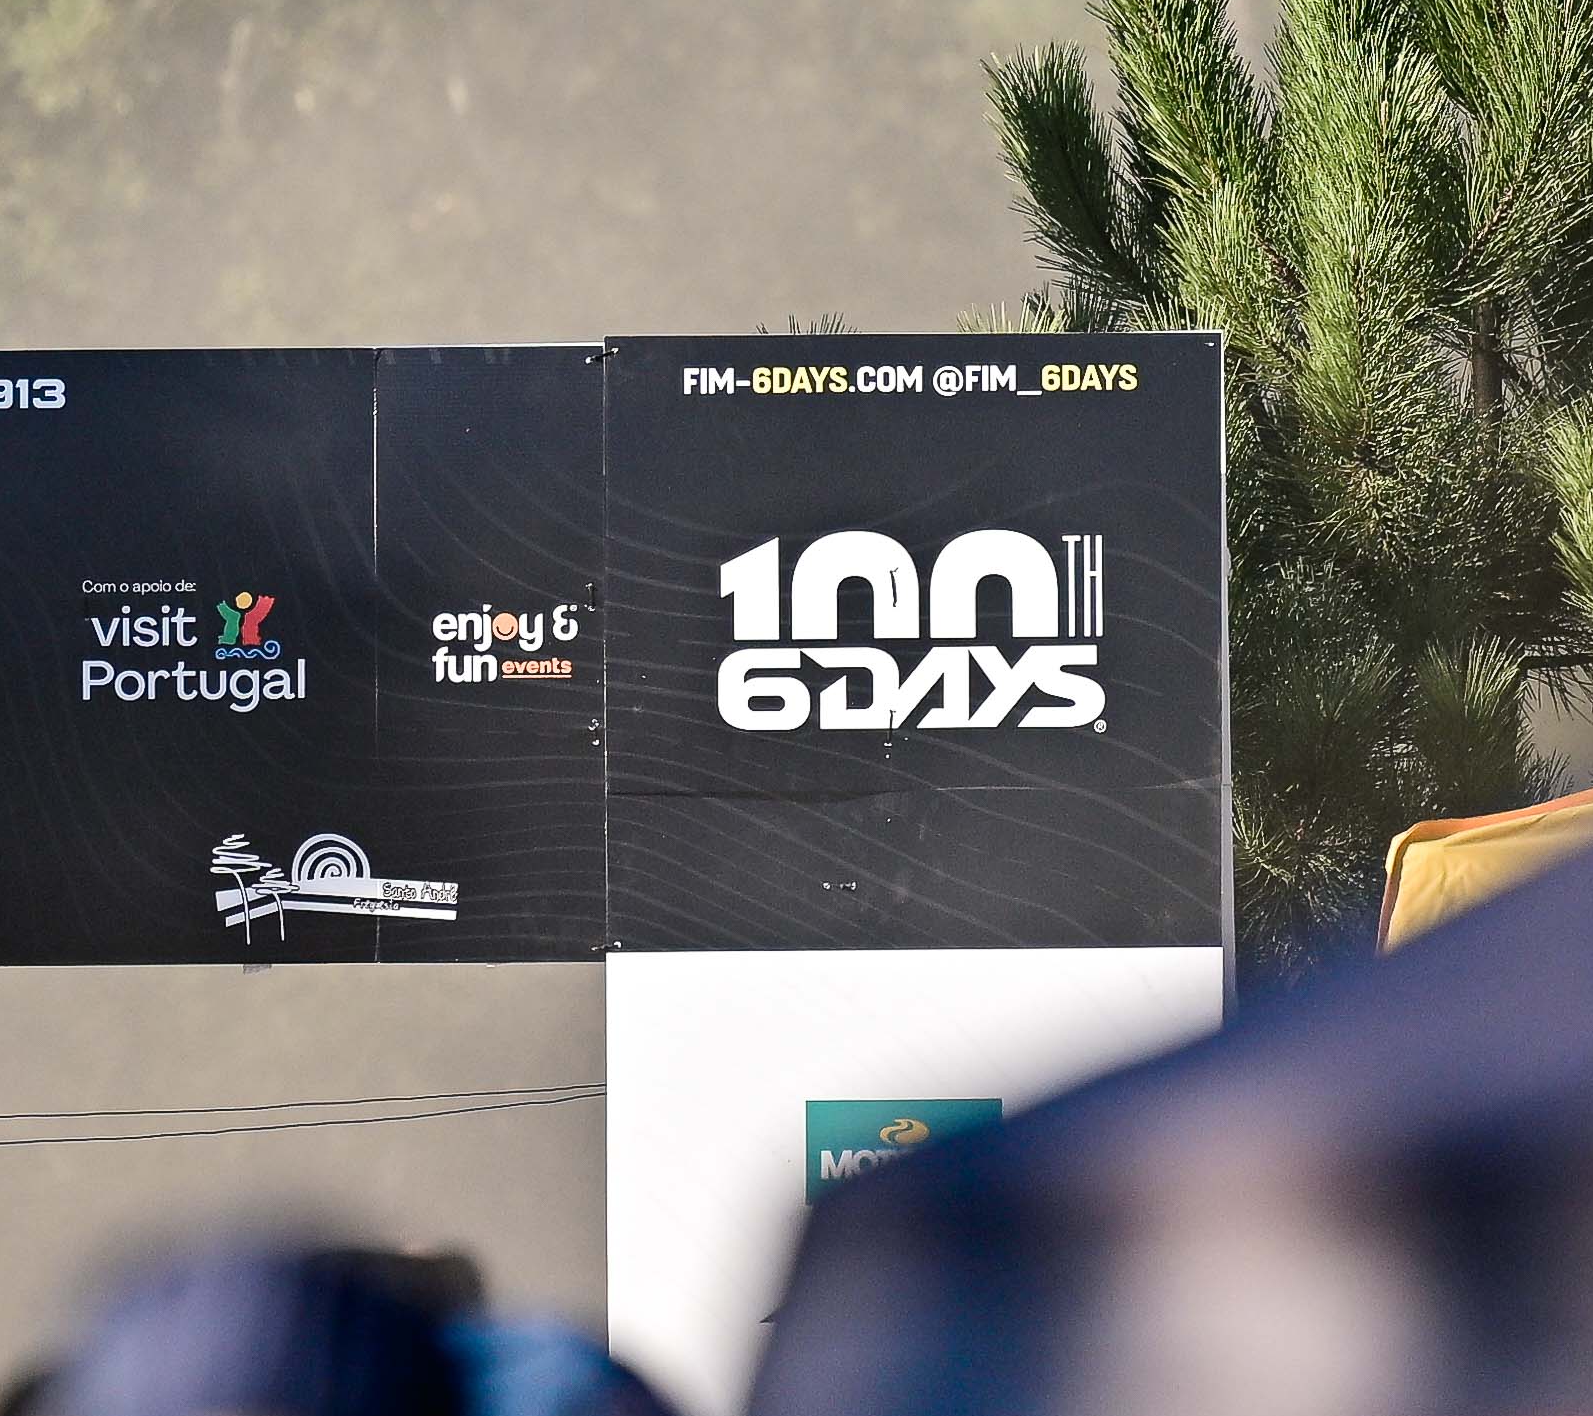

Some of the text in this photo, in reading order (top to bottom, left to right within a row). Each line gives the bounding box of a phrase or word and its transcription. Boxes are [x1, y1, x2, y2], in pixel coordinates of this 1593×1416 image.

[683, 364, 1138, 397] FIM-6DAYS.COM @FIM_6DAYS
[82, 580, 117, 593] Com
[119, 582, 129, 593] o
[132, 580, 172, 595] apoio
[90, 605, 198, 647] visit
[432, 604, 544, 652] enjoy
[431, 646, 573, 683] fun events
[82, 658, 306, 713] Portugal
